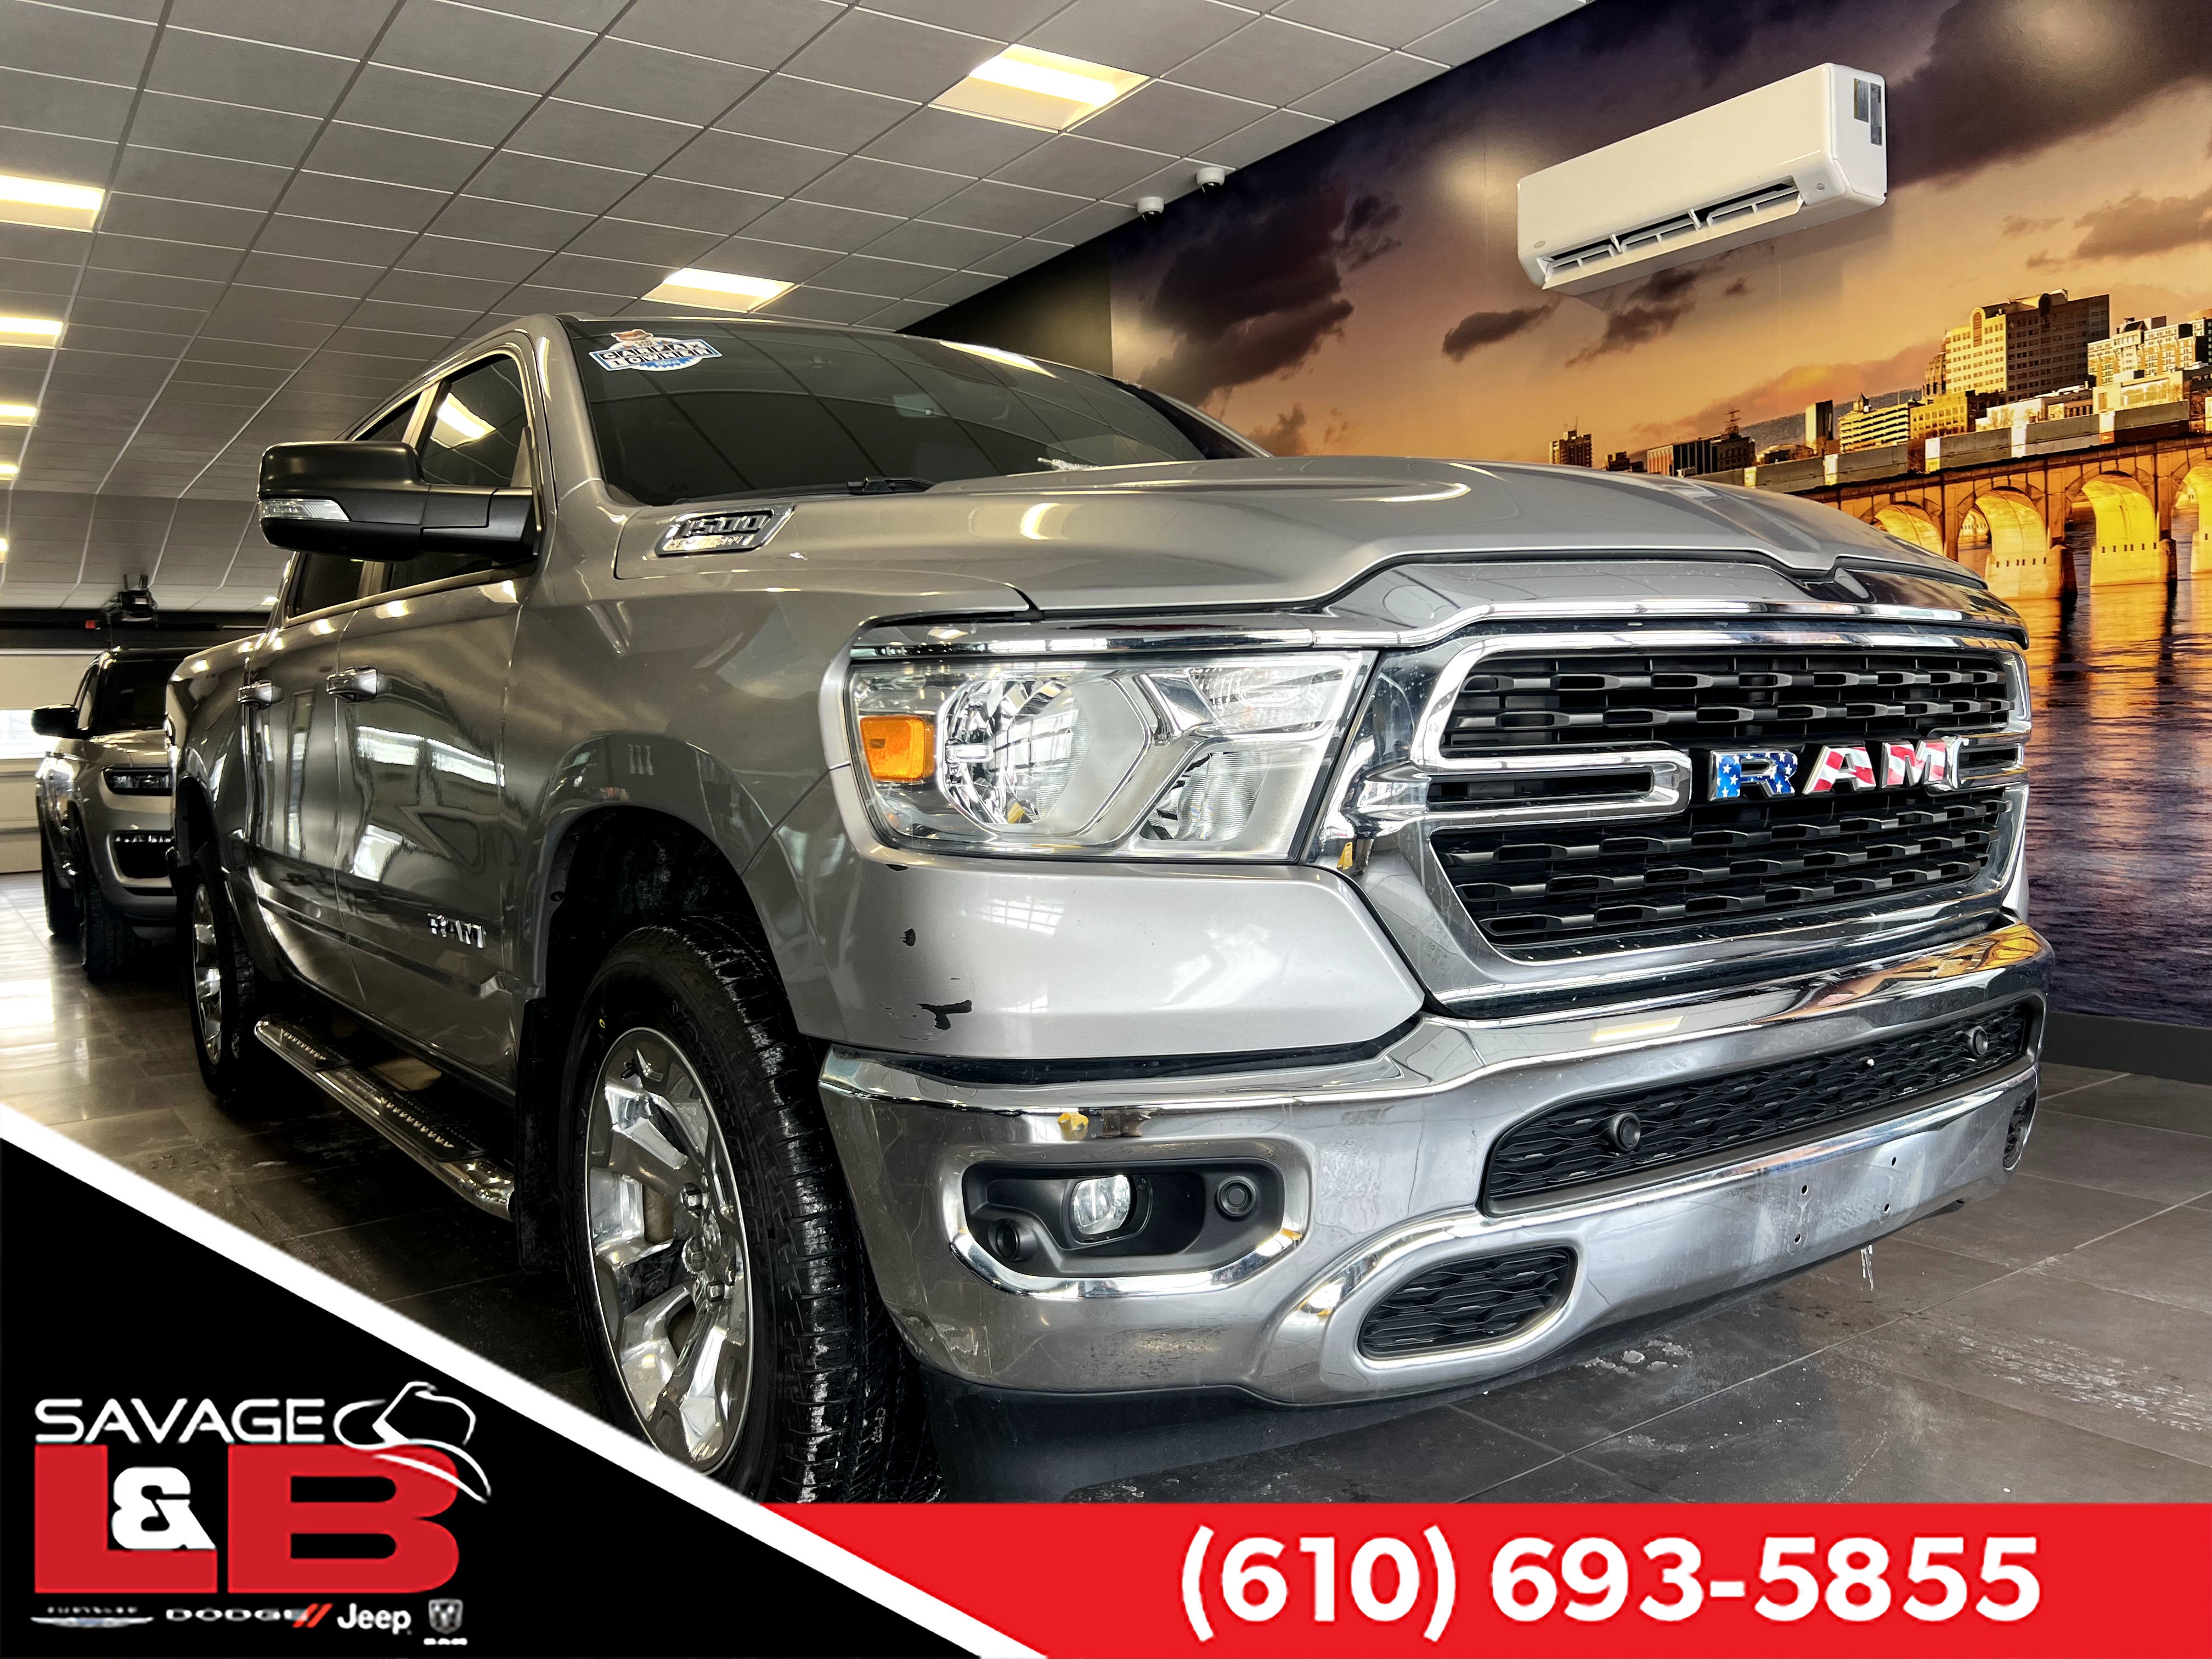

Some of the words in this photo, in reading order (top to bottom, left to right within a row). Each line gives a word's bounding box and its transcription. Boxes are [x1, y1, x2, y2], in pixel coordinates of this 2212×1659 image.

[603, 342, 703, 359] CARFAX
[628, 348, 710, 364] OWNER
[682, 515, 768, 537] 1500
[1708, 739, 1949, 802] RAM
[427, 913, 486, 948] RAM
